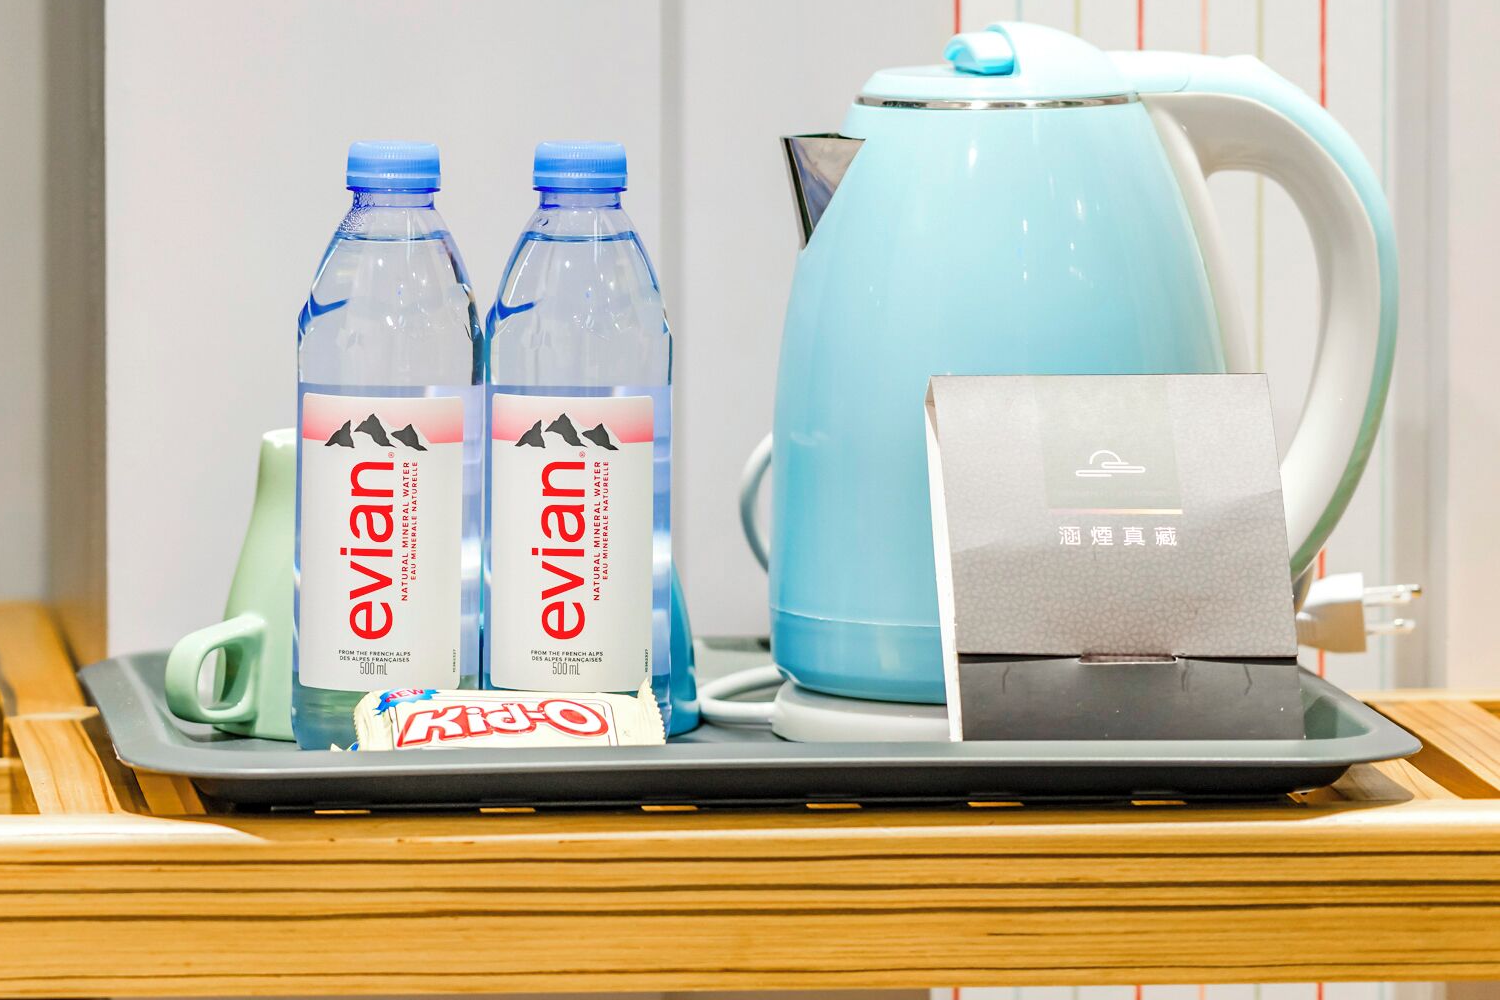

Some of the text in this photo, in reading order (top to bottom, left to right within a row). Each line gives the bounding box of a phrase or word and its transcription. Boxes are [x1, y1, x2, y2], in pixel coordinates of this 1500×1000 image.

[402, 501, 410, 549] MINERAL
[593, 460, 601, 601] NATURAL MINERAL WATER
[1058, 525, 1179, 547] 涵煙真藏
[340, 461, 394, 640] evian
[531, 460, 586, 640] evian
[401, 552, 409, 602] NATURAL
[359, 661, 388, 676] 500 mL
[552, 661, 581, 676] 500 mL
[385, 687, 425, 703] NEW
[396, 699, 609, 747] Kid-O
